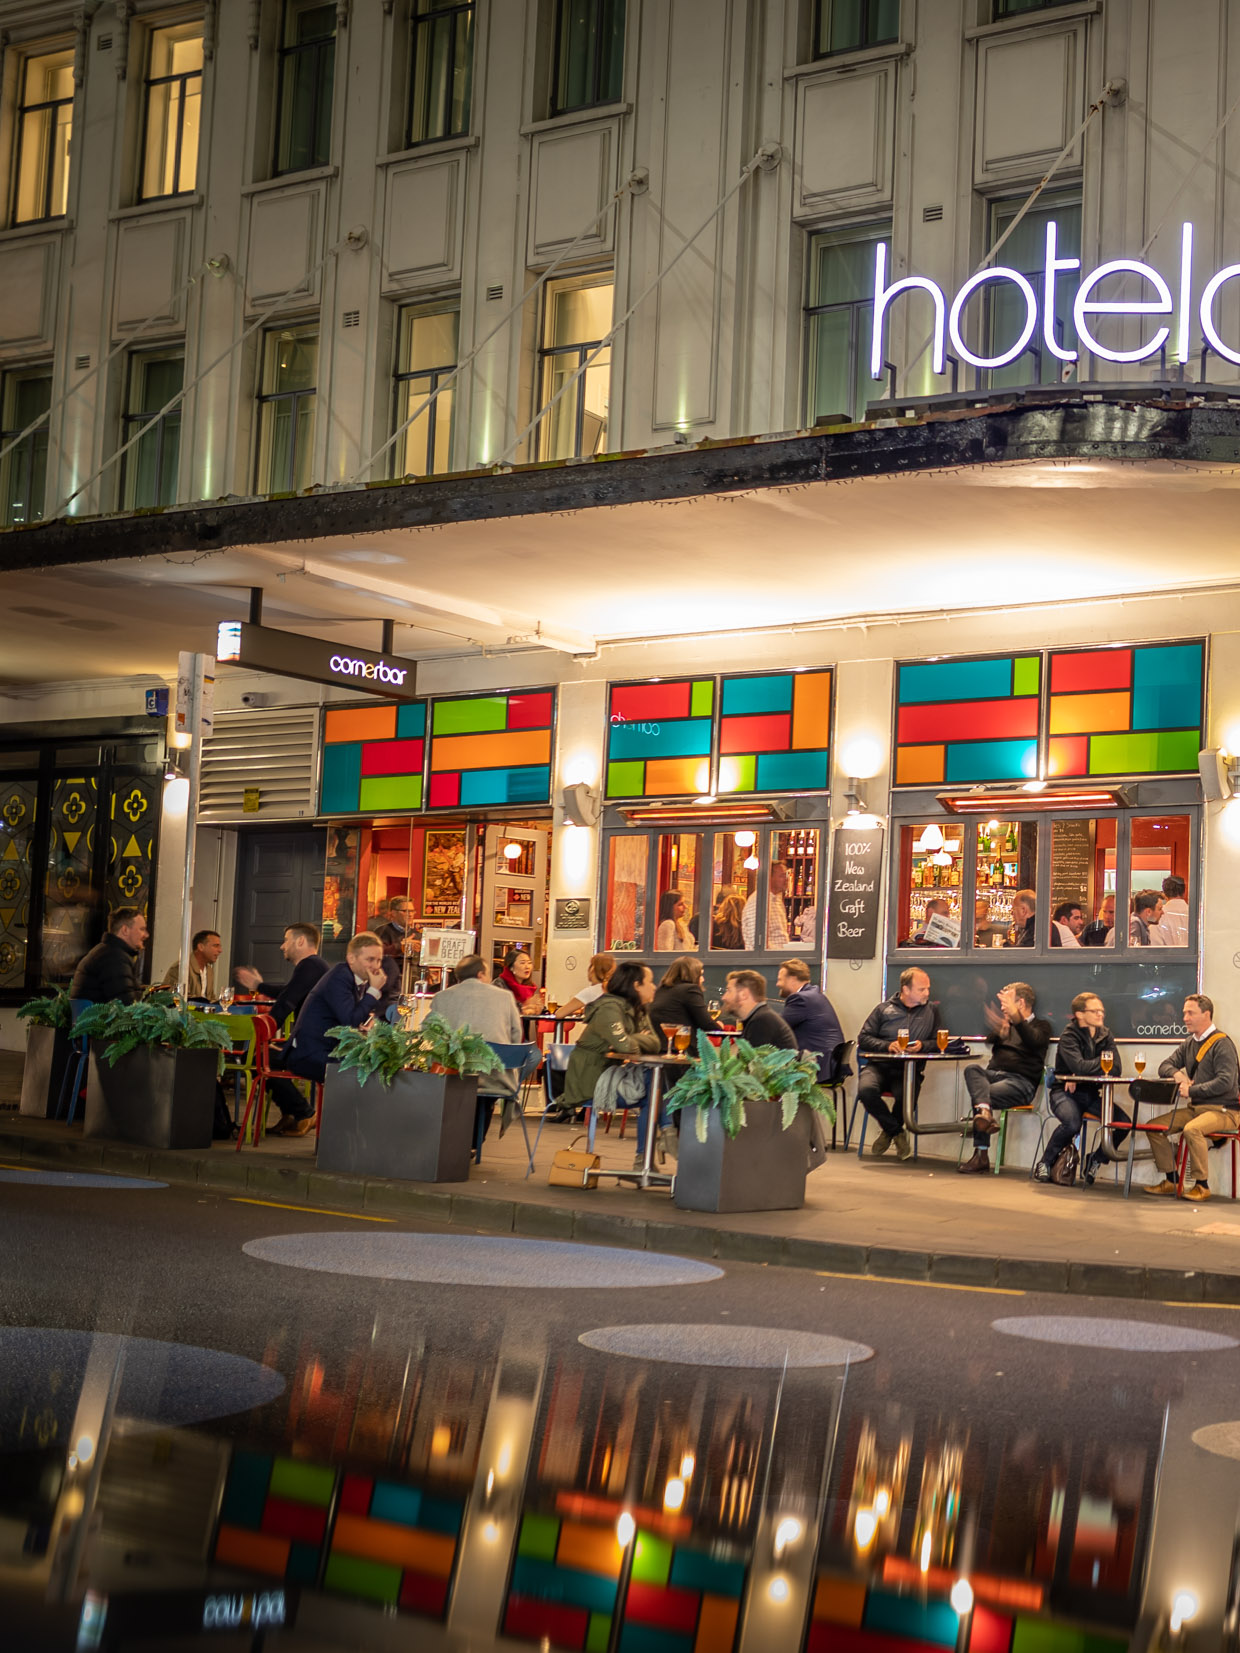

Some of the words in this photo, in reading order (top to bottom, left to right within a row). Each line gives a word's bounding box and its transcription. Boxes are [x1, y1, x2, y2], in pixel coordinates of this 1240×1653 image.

[329, 655, 407, 685] cornerbar
[845, 842, 872, 856] 100%
[845, 861, 865, 875] New
[834, 880, 874, 893] Zealand
[434, 905, 446, 914] NEW
[839, 899, 865, 918] Craft
[837, 921, 865, 938] Beer
[442, 940, 466, 950] CRAFT
[1136, 1022, 1190, 1035] cornerba
